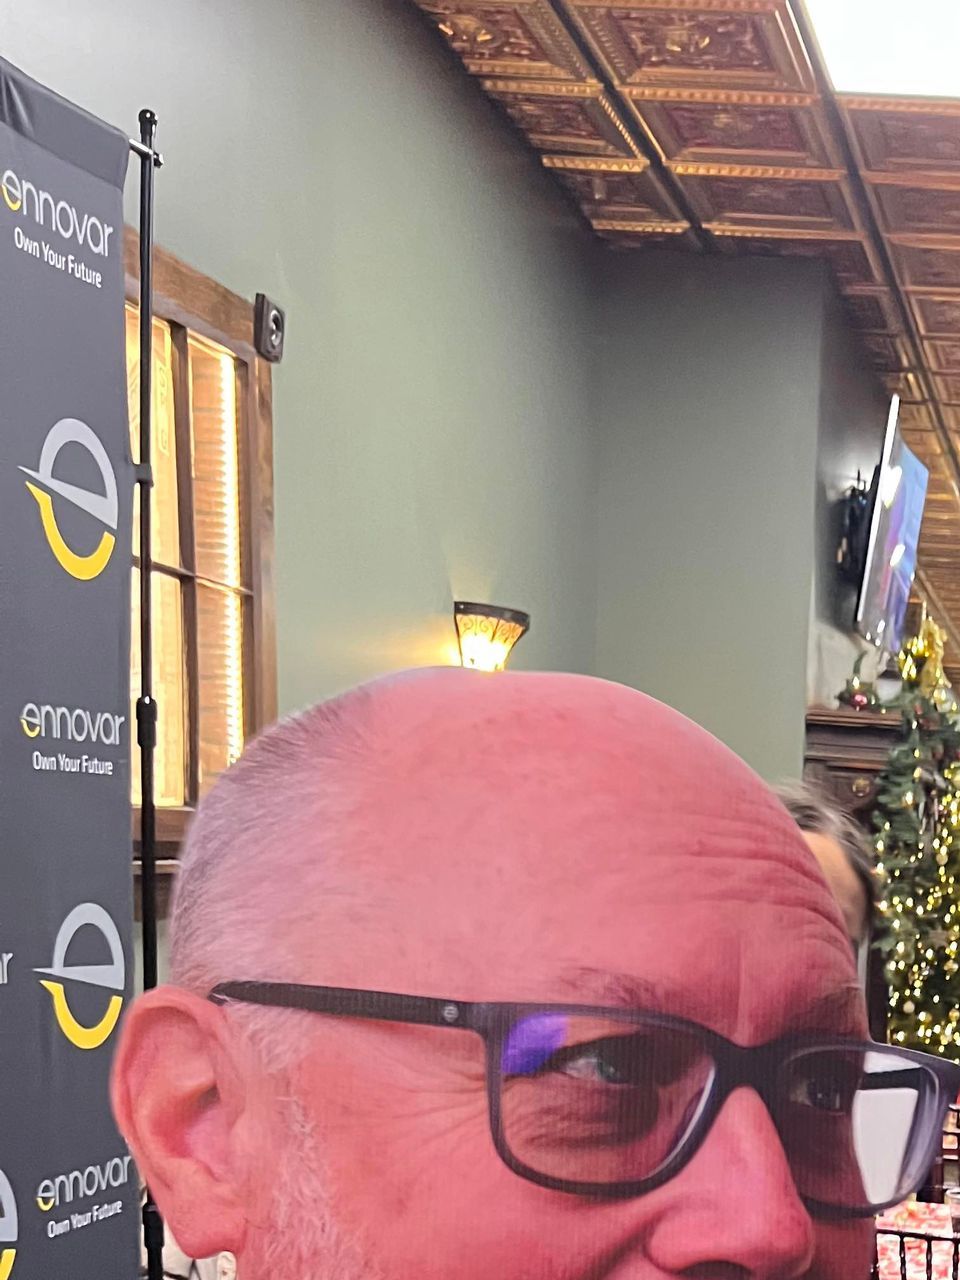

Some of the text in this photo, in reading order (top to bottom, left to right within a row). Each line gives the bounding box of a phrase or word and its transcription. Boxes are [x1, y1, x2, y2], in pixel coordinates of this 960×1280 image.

[1, 169, 114, 257] ennovar
[14, 226, 102, 288] Own Your Future
[20, 703, 125, 745] ennovar
[32, 751, 113, 775] Own Your Future
[36, 1156, 131, 1211] ennovar
